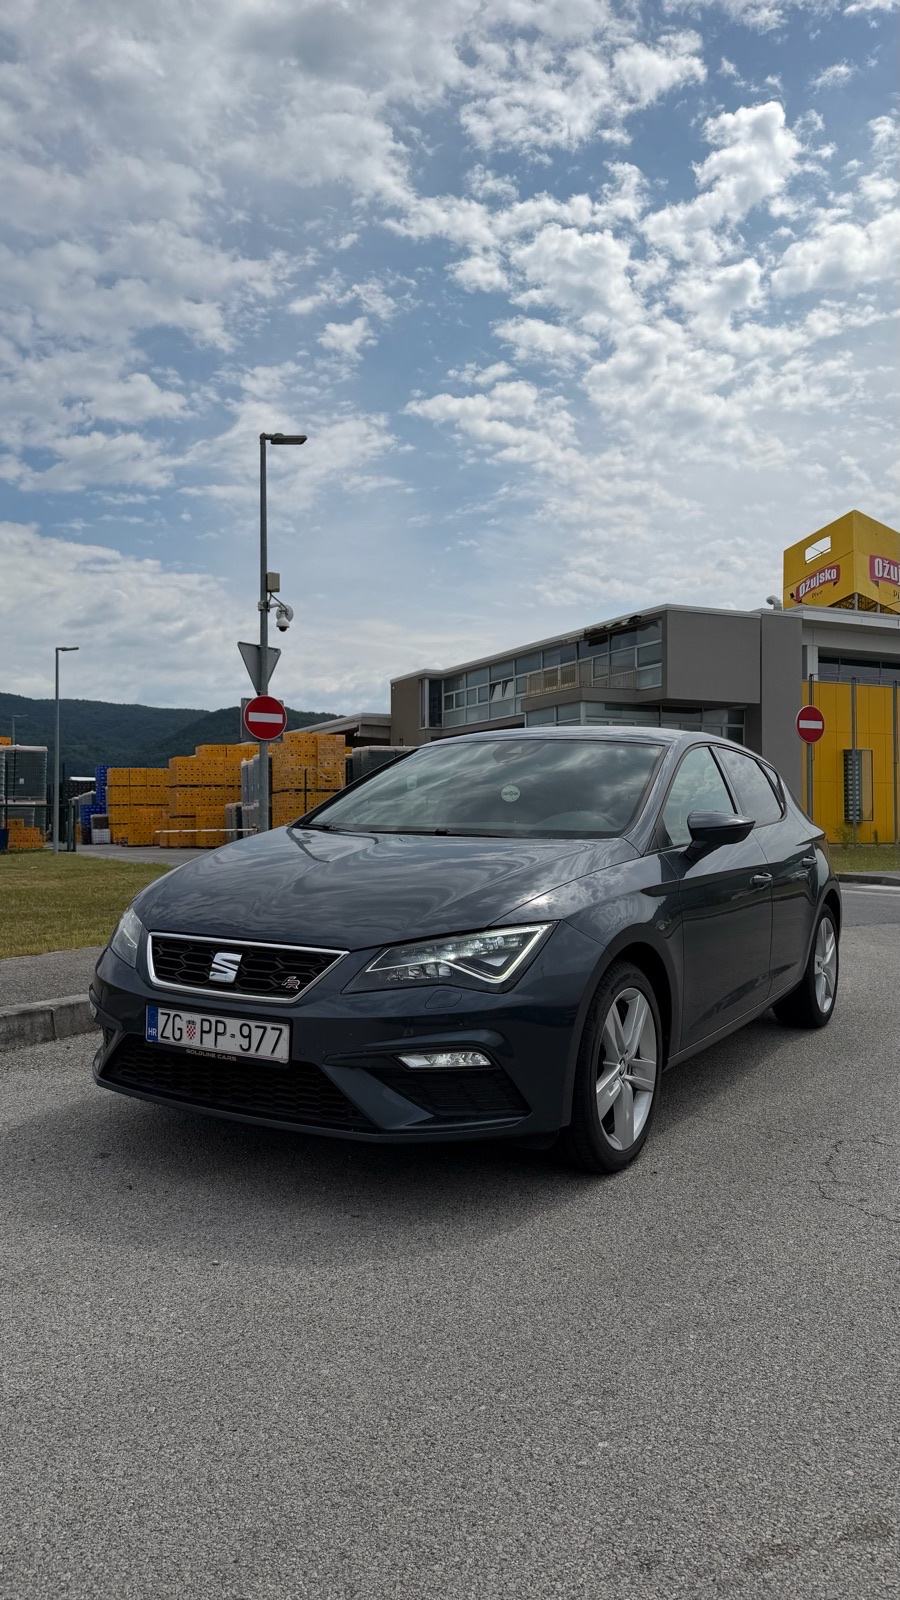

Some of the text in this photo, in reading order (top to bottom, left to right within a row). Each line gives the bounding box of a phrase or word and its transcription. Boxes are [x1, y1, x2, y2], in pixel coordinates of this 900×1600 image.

[799, 568, 837, 597] Ožujsko
[148, 1028, 157, 1037] HR
[160, 1012, 283, 1055] ZG PP-977
[217, 1054, 237, 1062] CARS
